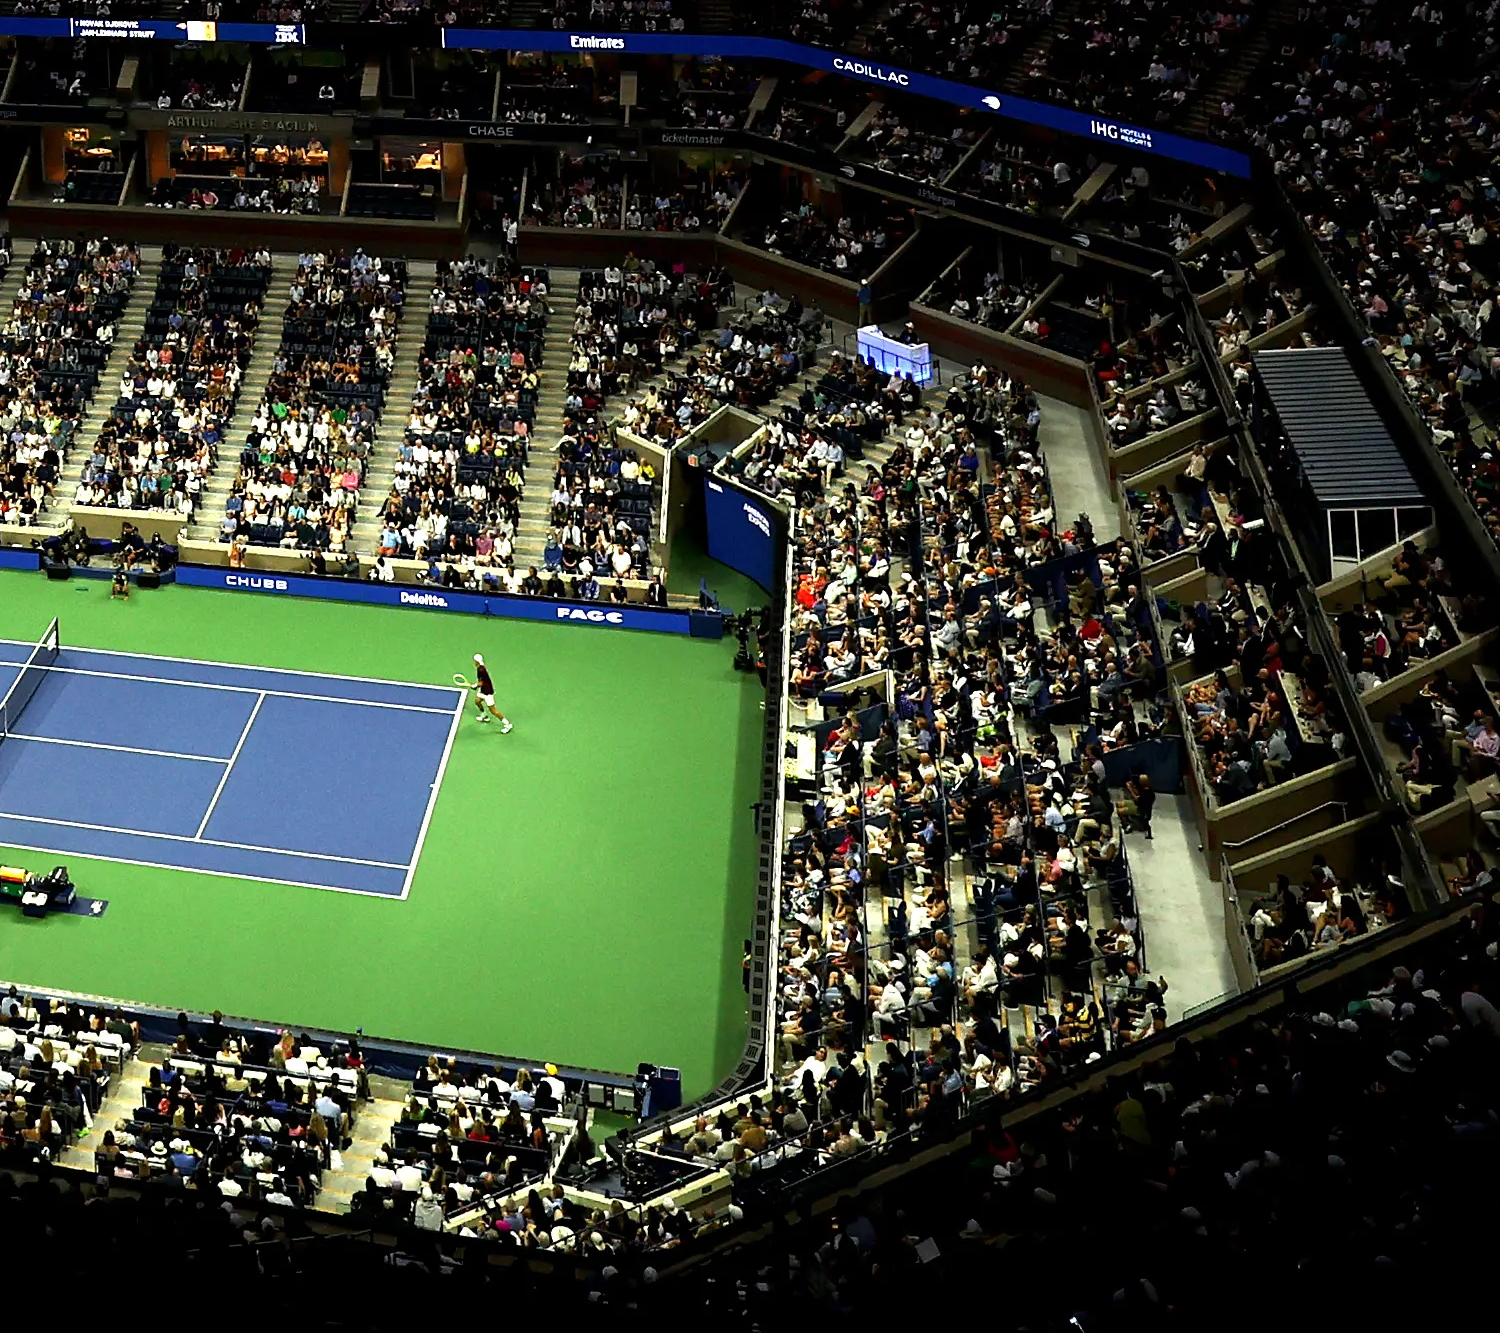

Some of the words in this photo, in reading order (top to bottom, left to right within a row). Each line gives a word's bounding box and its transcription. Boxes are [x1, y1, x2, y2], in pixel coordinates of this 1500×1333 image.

[275, 31, 300, 43] IBM
[570, 35, 625, 50] Emirates
[833, 57, 909, 87] CADILLAC
[167, 116, 217, 129] ARTHUR
[1091, 120, 1118, 139] IHG
[469, 125, 514, 137] CHASE
[661, 132, 724, 145] ticketmaster
[226, 575, 288, 590] CHUBB
